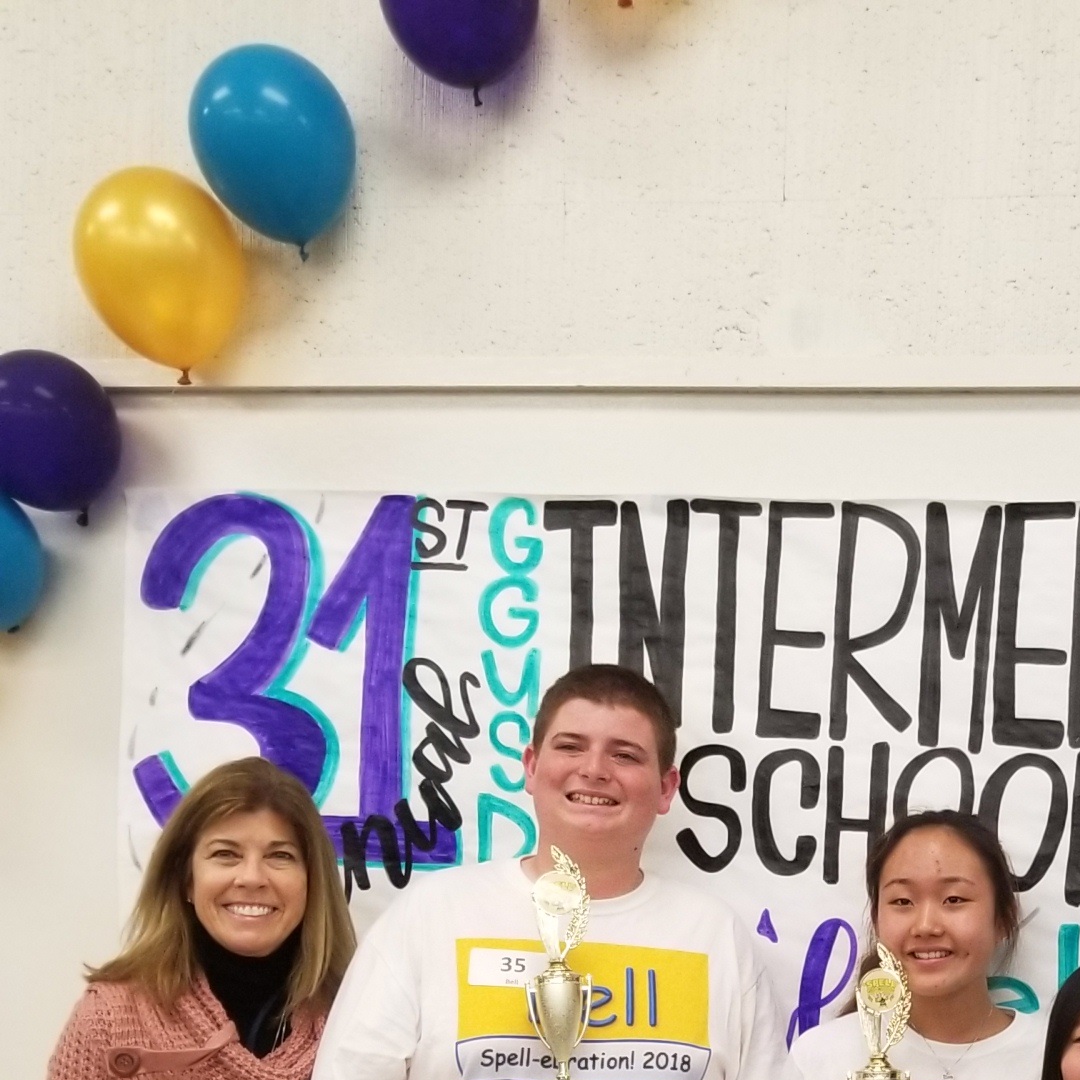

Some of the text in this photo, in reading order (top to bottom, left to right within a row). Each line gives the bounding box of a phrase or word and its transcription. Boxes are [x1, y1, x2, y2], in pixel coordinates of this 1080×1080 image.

[341, 657, 481, 904] nual
[500, 956, 526, 973] 35
[529, 967, 657, 1028] ell
[642, 1051, 692, 1073] 2018
